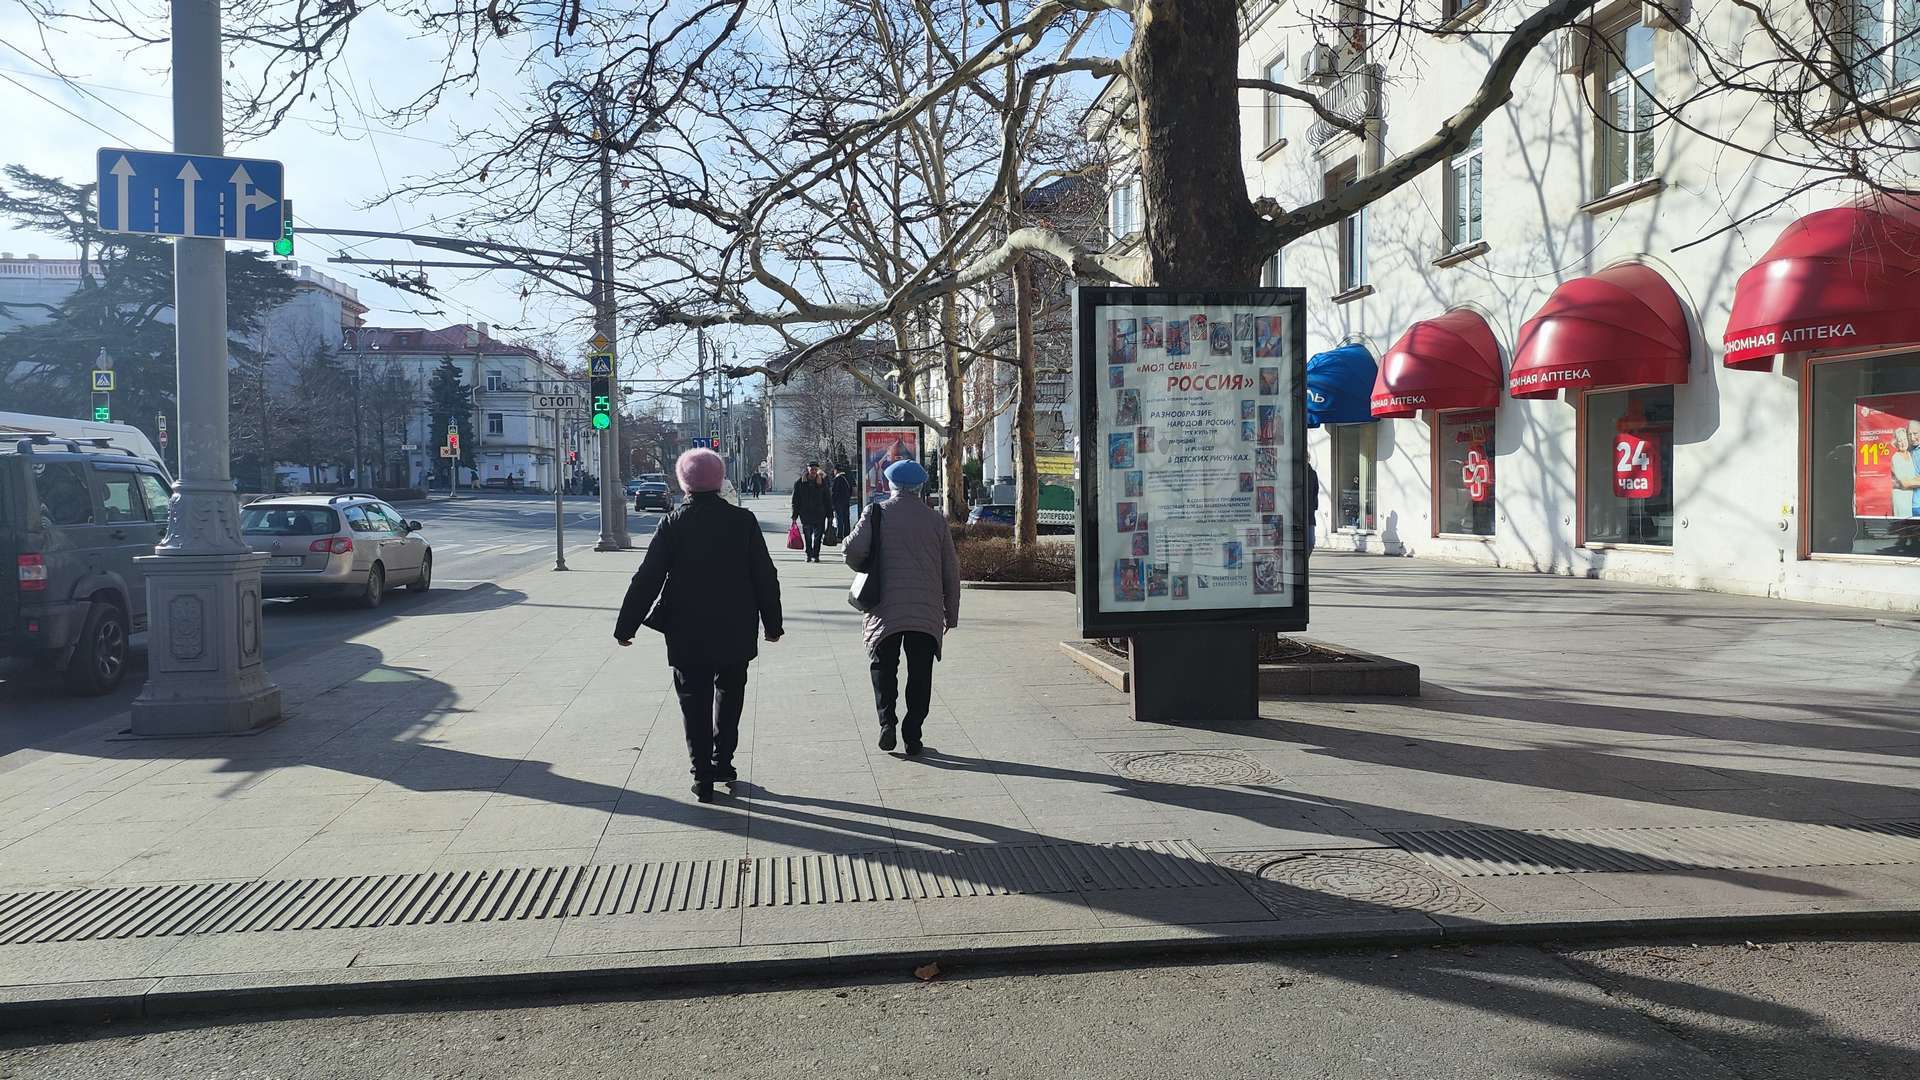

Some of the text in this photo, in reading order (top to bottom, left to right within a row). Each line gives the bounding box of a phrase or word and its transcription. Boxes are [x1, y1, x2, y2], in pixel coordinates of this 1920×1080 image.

[284, 220, 293, 236] 5
[1724, 323, 1857, 354] ОНОМНАЯ АПТЕКА
[1136, 363, 1165, 373] «МОЯ
[1167, 361, 1198, 371] СЕМЬЯ
[1540, 368, 1592, 383] АПТЕКА
[1167, 374, 1254, 392] РОССИЯ»
[539, 396, 573, 407] СТОП
[594, 395, 610, 411] 25
[1390, 395, 1426, 406] АПТЕКА
[95, 407, 109, 420] 25
[1150, 410, 1213, 418] РАЗНООБРАЗИЕ
[1167, 419, 1203, 428] НАРОДОВ
[1173, 455, 1209, 464] ДЕТСКИХ
[1616, 440, 1650, 472] 24
[1860, 442, 1890, 465] 11%
[1618, 477, 1648, 490] часа
